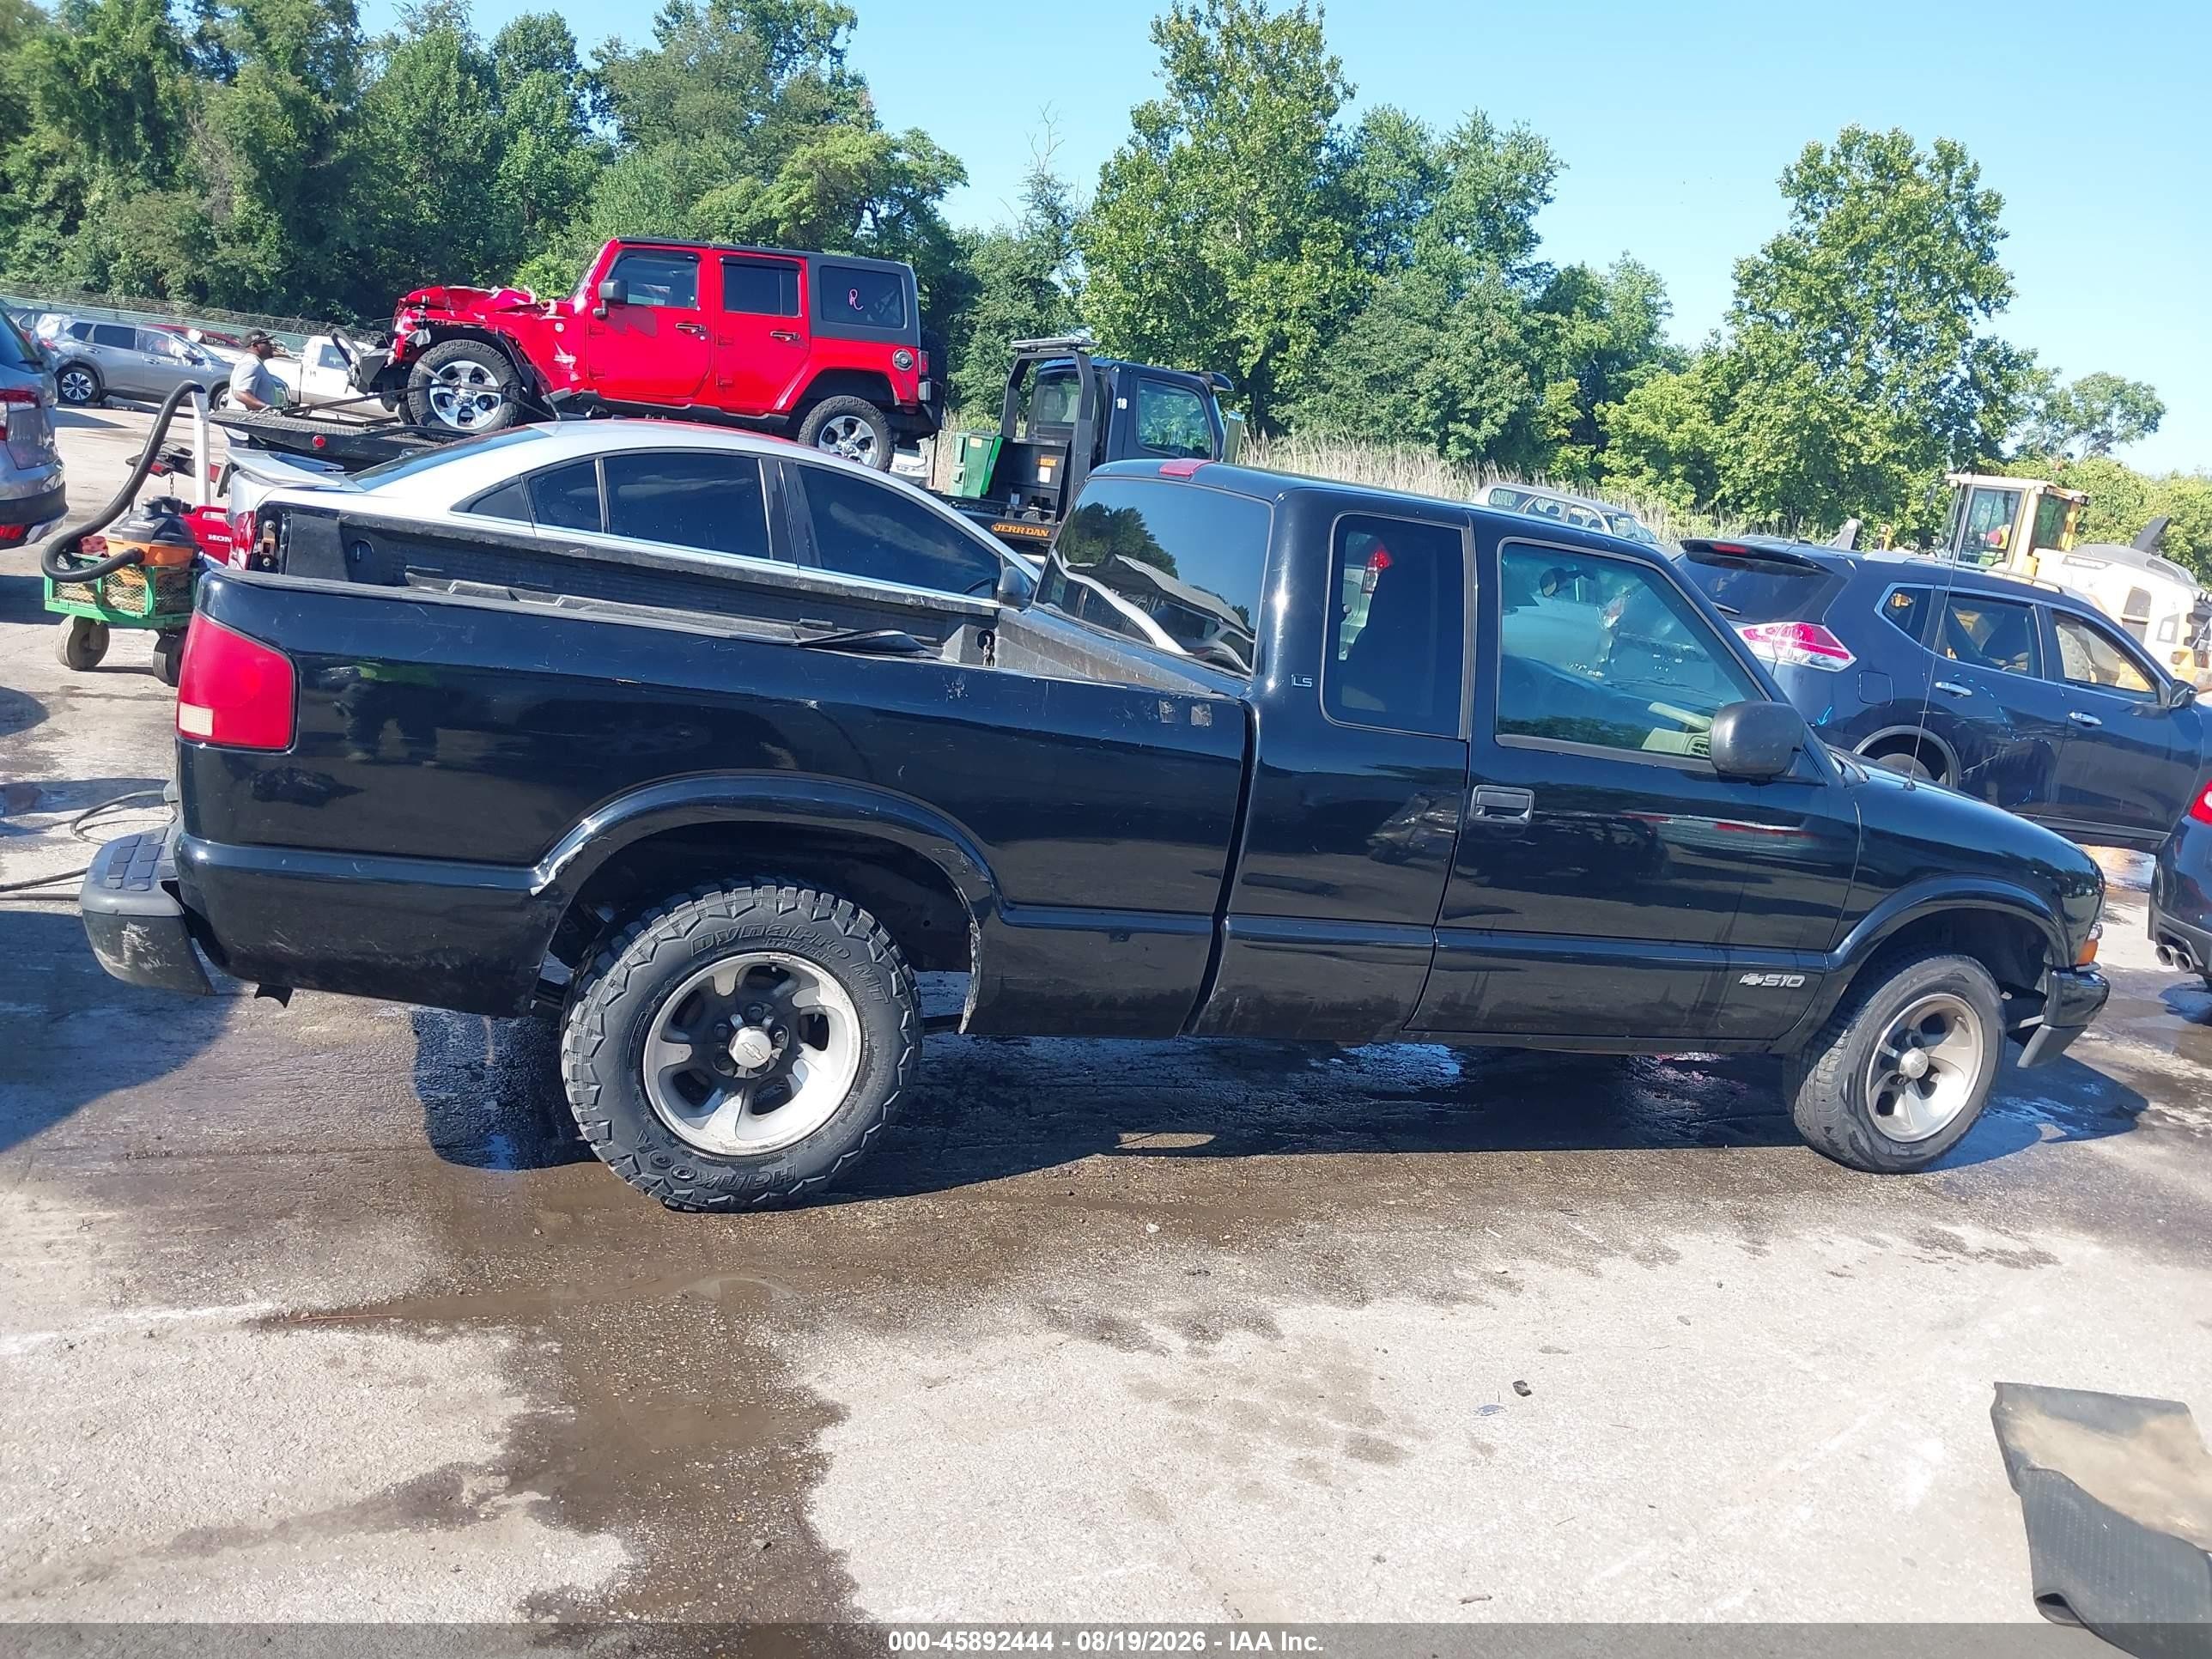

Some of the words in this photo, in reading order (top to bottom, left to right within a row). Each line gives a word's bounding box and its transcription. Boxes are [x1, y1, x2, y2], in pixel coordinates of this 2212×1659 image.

[848, 289, 864, 311] R
[1293, 676, 1313, 687] LS
[1760, 974, 1805, 987] S10
